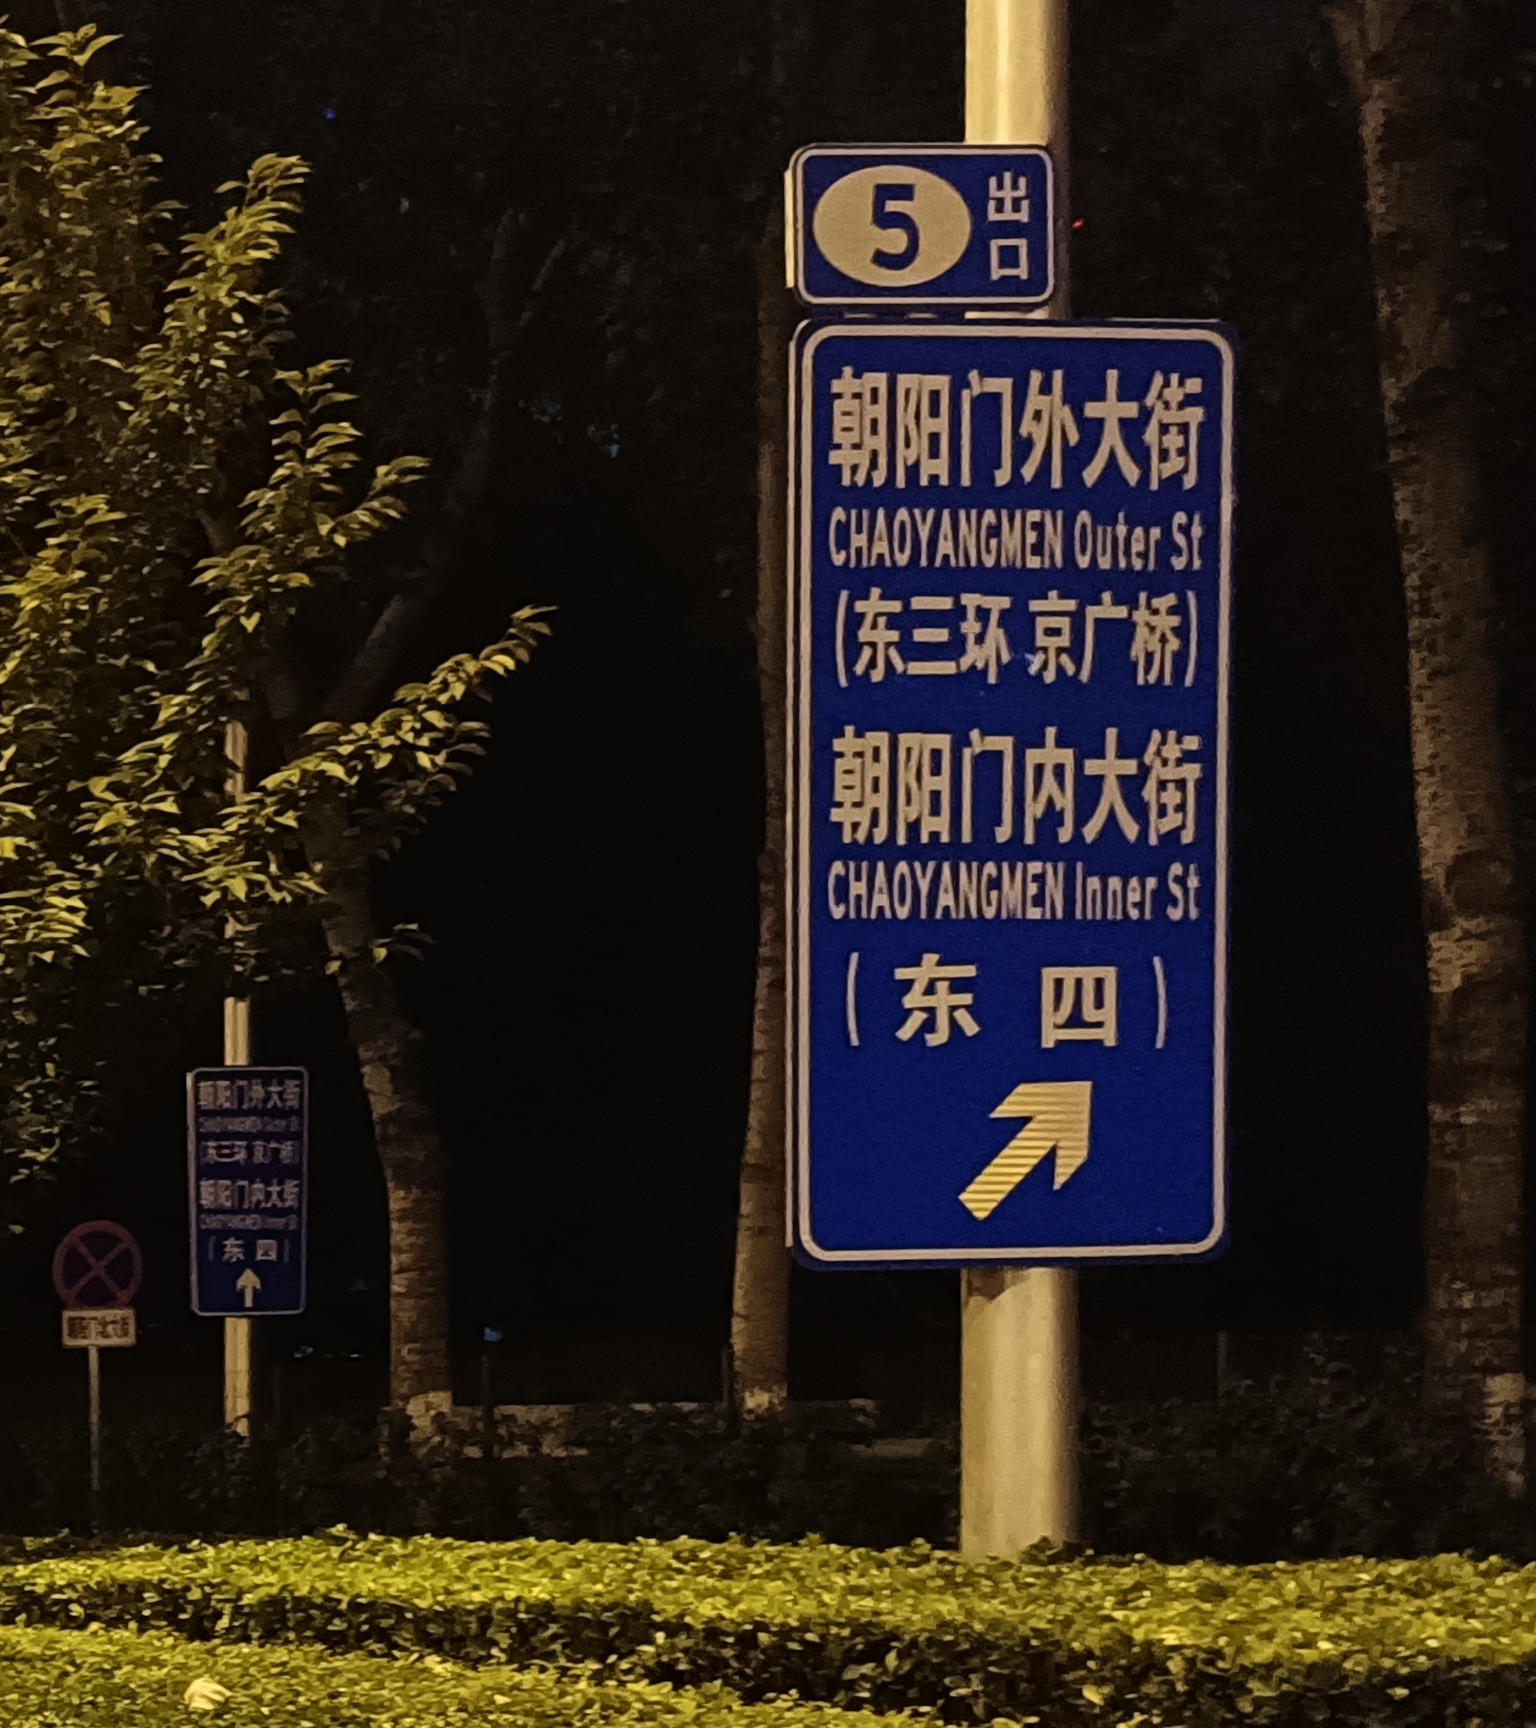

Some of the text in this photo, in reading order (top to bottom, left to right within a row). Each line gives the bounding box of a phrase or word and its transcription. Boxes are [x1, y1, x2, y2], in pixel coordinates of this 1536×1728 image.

[869, 182, 921, 272] 5
[987, 171, 1029, 281] 出口
[828, 366, 1205, 491] 朝阳门外大街
[829, 507, 1204, 571] CHAOYANGMEN Outer St
[829, 726, 1203, 846] 朝阳门内大街
[828, 860, 1201, 922] CHAOYANGMEN Inner St
